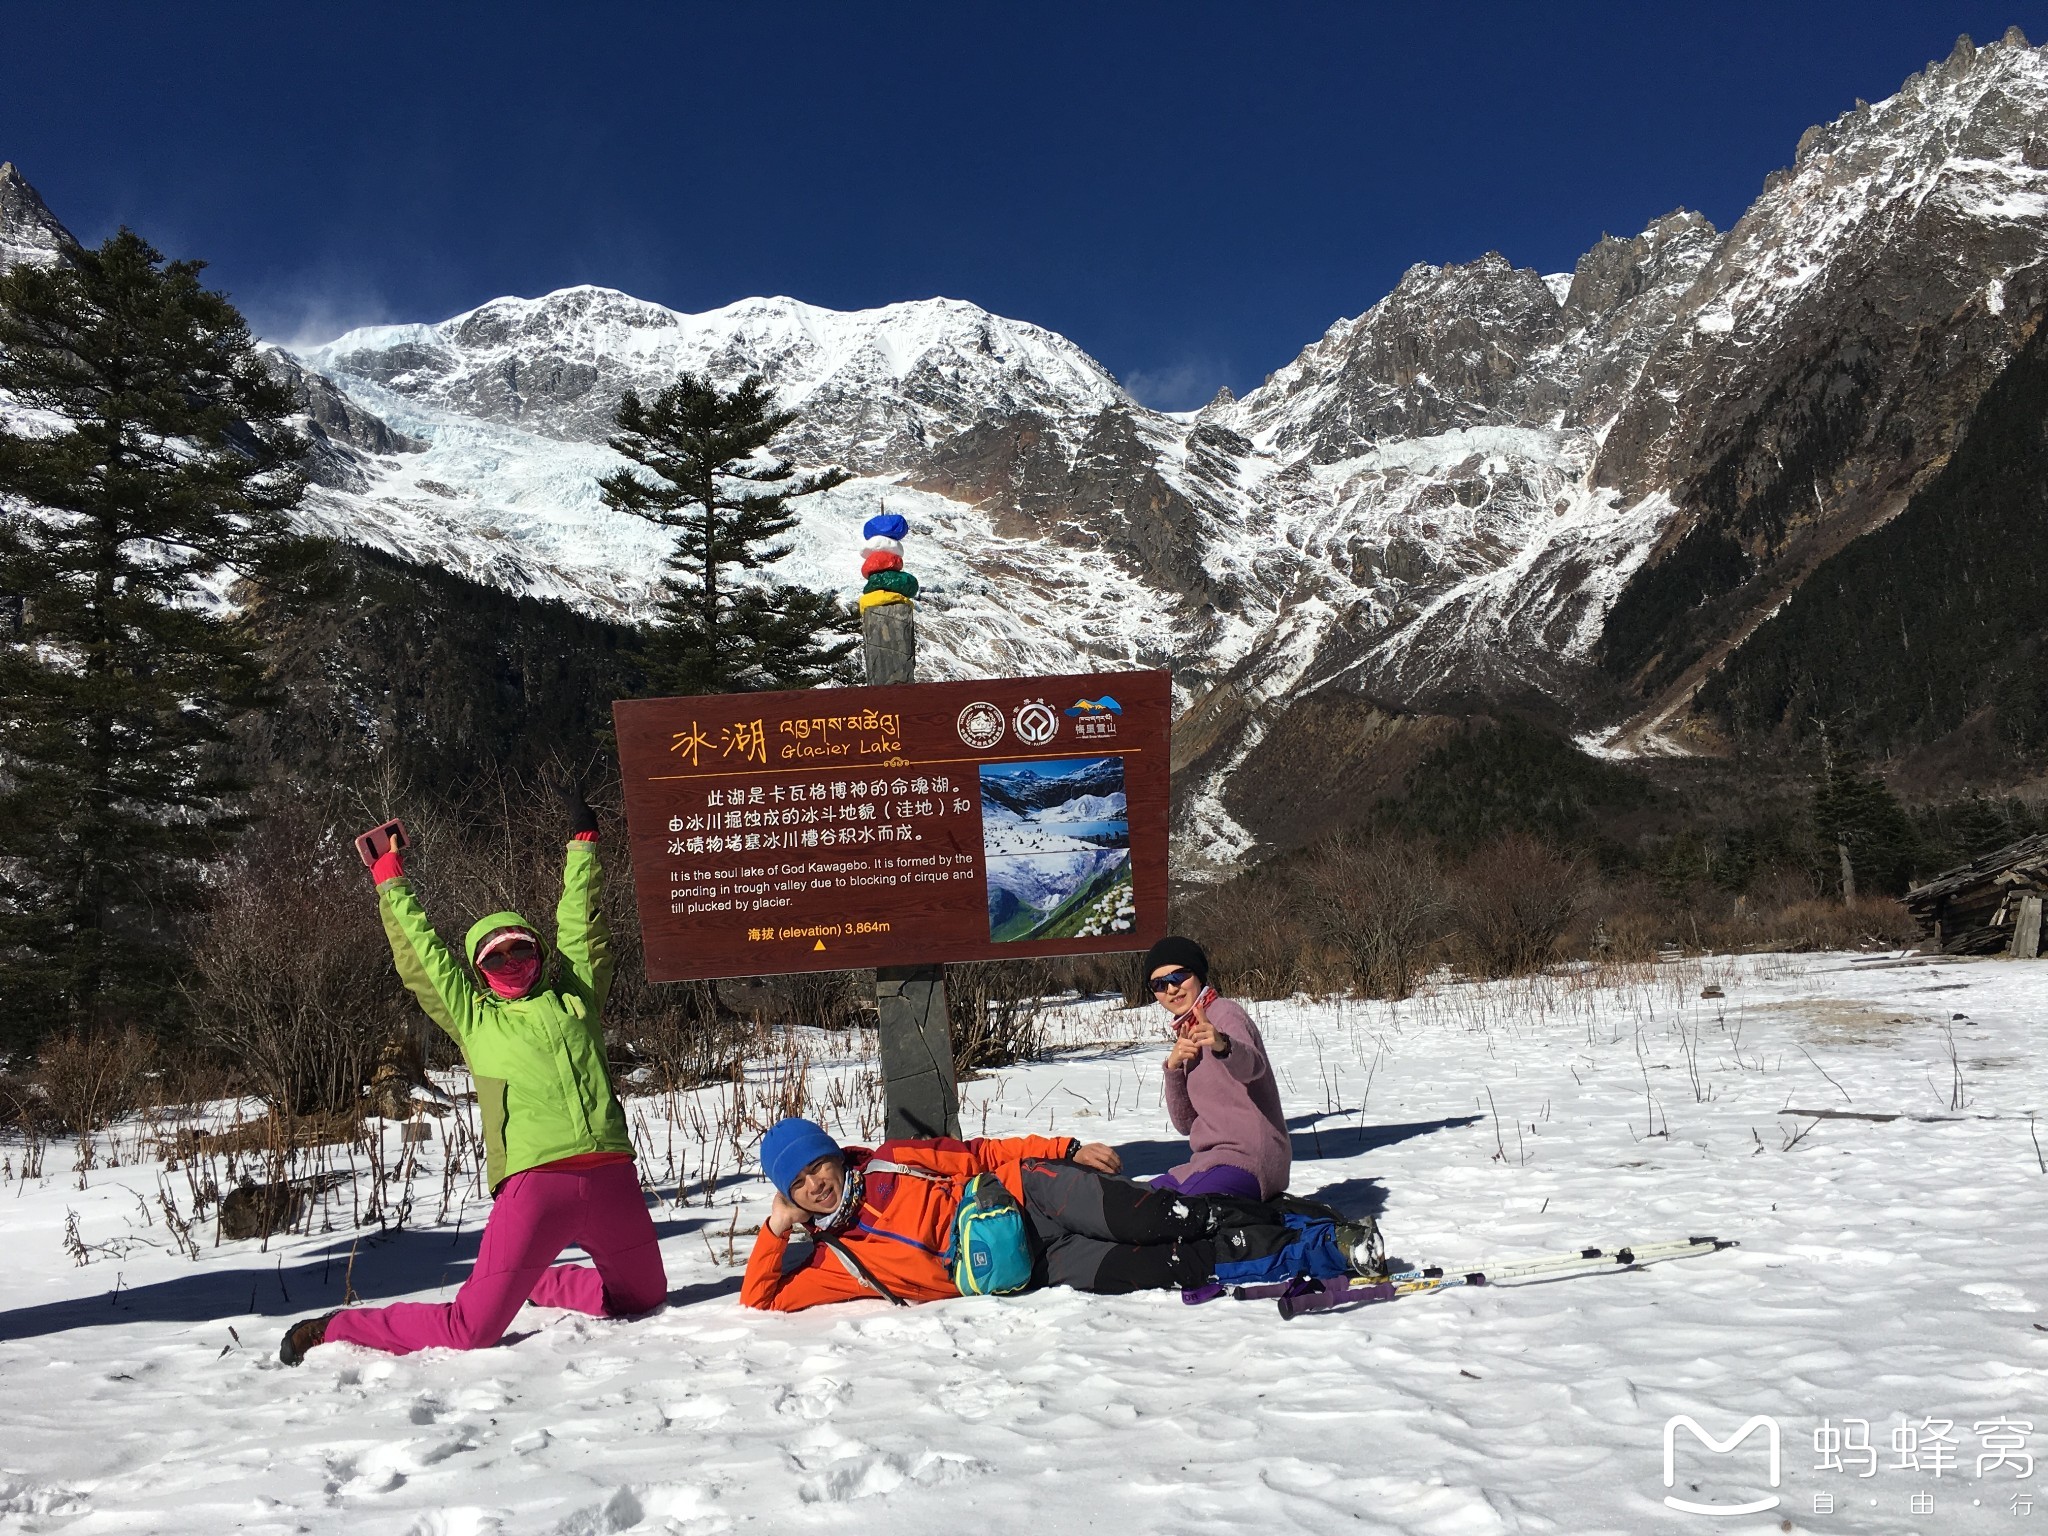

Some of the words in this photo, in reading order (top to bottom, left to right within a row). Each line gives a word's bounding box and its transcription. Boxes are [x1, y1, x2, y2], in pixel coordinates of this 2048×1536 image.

[670, 718, 767, 767] 冰湖
[781, 742, 851, 759] Glacier
[860, 734, 902, 754] Lake
[707, 776, 960, 807] 此湖是卡瓦格博神的命魂湖。
[667, 823, 923, 856] 冰碛物堵塞冰川槽谷积水而成。
[670, 872, 678, 882] It
[681, 871, 690, 881] is
[693, 870, 711, 880] the
[714, 868, 738, 879] soul
[741, 866, 764, 877] lake
[767, 865, 779, 875] of
[781, 863, 805, 875] God
[808, 860, 871, 874] Kawagebo.
[874, 859, 882, 869] It
[884, 858, 894, 868] is
[897, 855, 936, 867] formed
[939, 855, 952, 867] by
[955, 854, 973, 864] the
[671, 885, 716, 900] ponding
[720, 884, 730, 895] in
[734, 882, 770, 894] trough
[774, 880, 807, 892] valley
[810, 878, 832, 888] due
[835, 877, 847, 887] to
[850, 874, 897, 886] blocking
[900, 872, 912, 883] of
[914, 871, 949, 883] cirque
[953, 869, 974, 880] and
[671, 903, 684, 914] till
[687, 900, 732, 915] plucked
[735, 899, 749, 911] by
[752, 897, 793, 910] glacier.
[748, 927, 775, 941] 海拔
[778, 924, 842, 940] (elevation)
[845, 922, 890, 935] 3,864m
